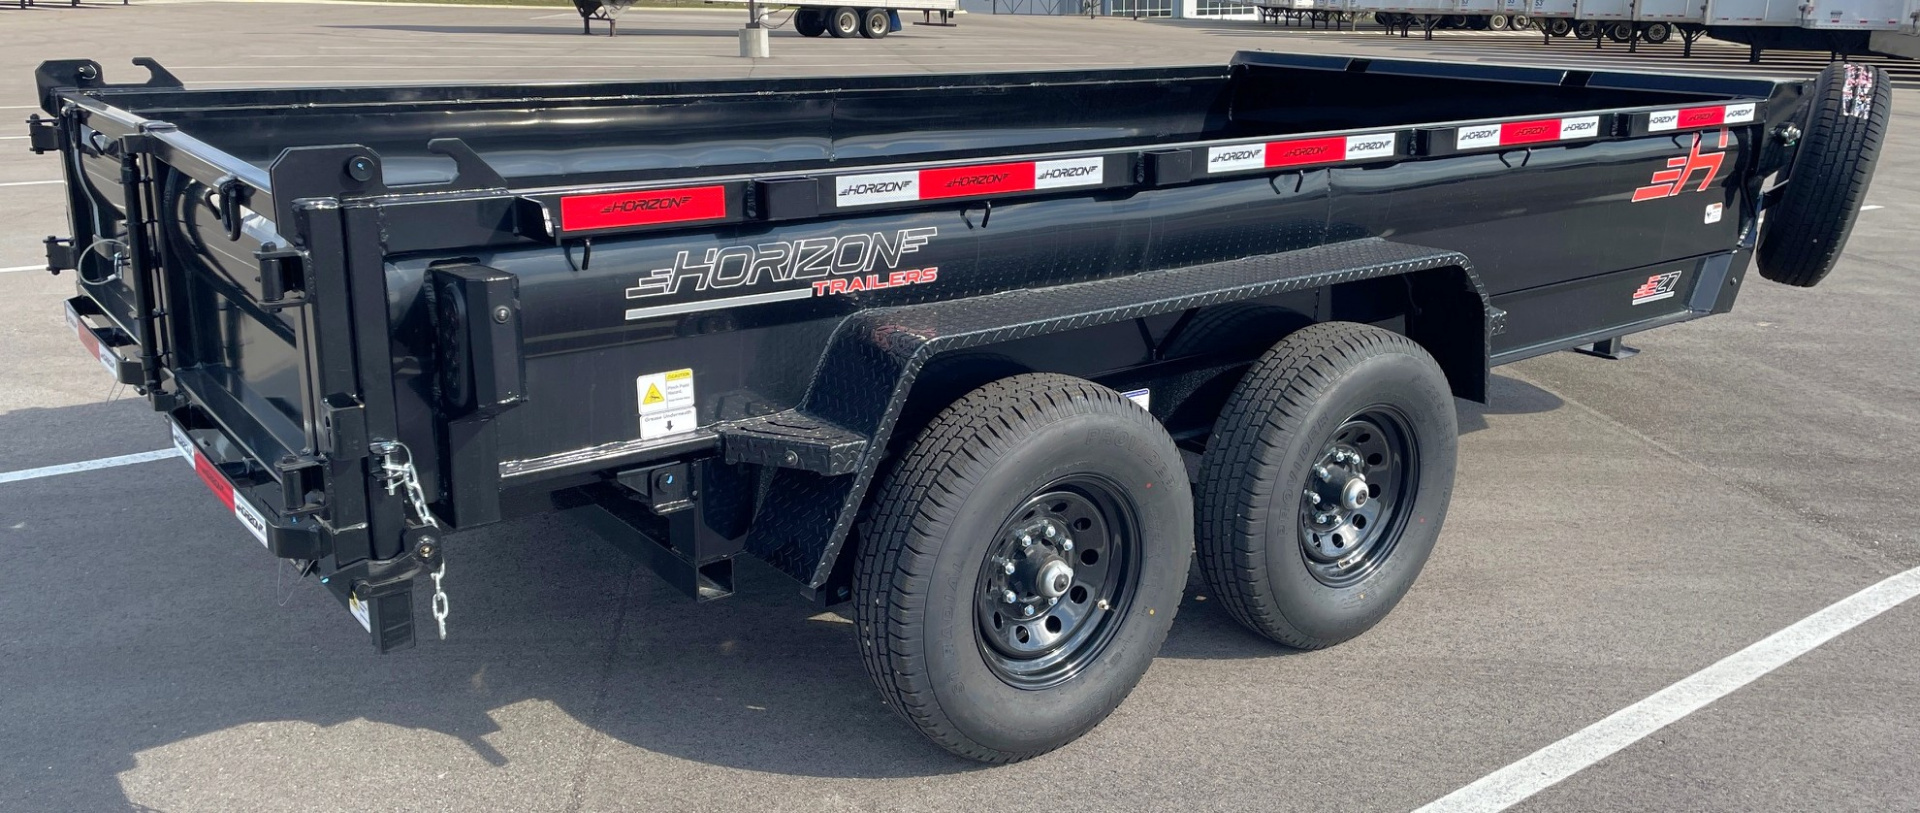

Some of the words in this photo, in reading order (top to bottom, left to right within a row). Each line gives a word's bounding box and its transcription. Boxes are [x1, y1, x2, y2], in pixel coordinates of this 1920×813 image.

[1462, 129, 1497, 141] HORIZON
[1564, 121, 1595, 132] HORIZON
[1213, 149, 1260, 163] HORIZON
[1285, 145, 1327, 157] HORIZON
[1350, 140, 1390, 152] HORIZON
[842, 180, 909, 197] HORIZON
[949, 173, 1007, 188] HORIZON
[1040, 165, 1096, 180] HORIZON
[604, 197, 690, 213] HORIZON
[642, 227, 922, 297] HORIZON
[812, 267, 938, 297] TRAILERS
[663, 410, 692, 419] Underneath
